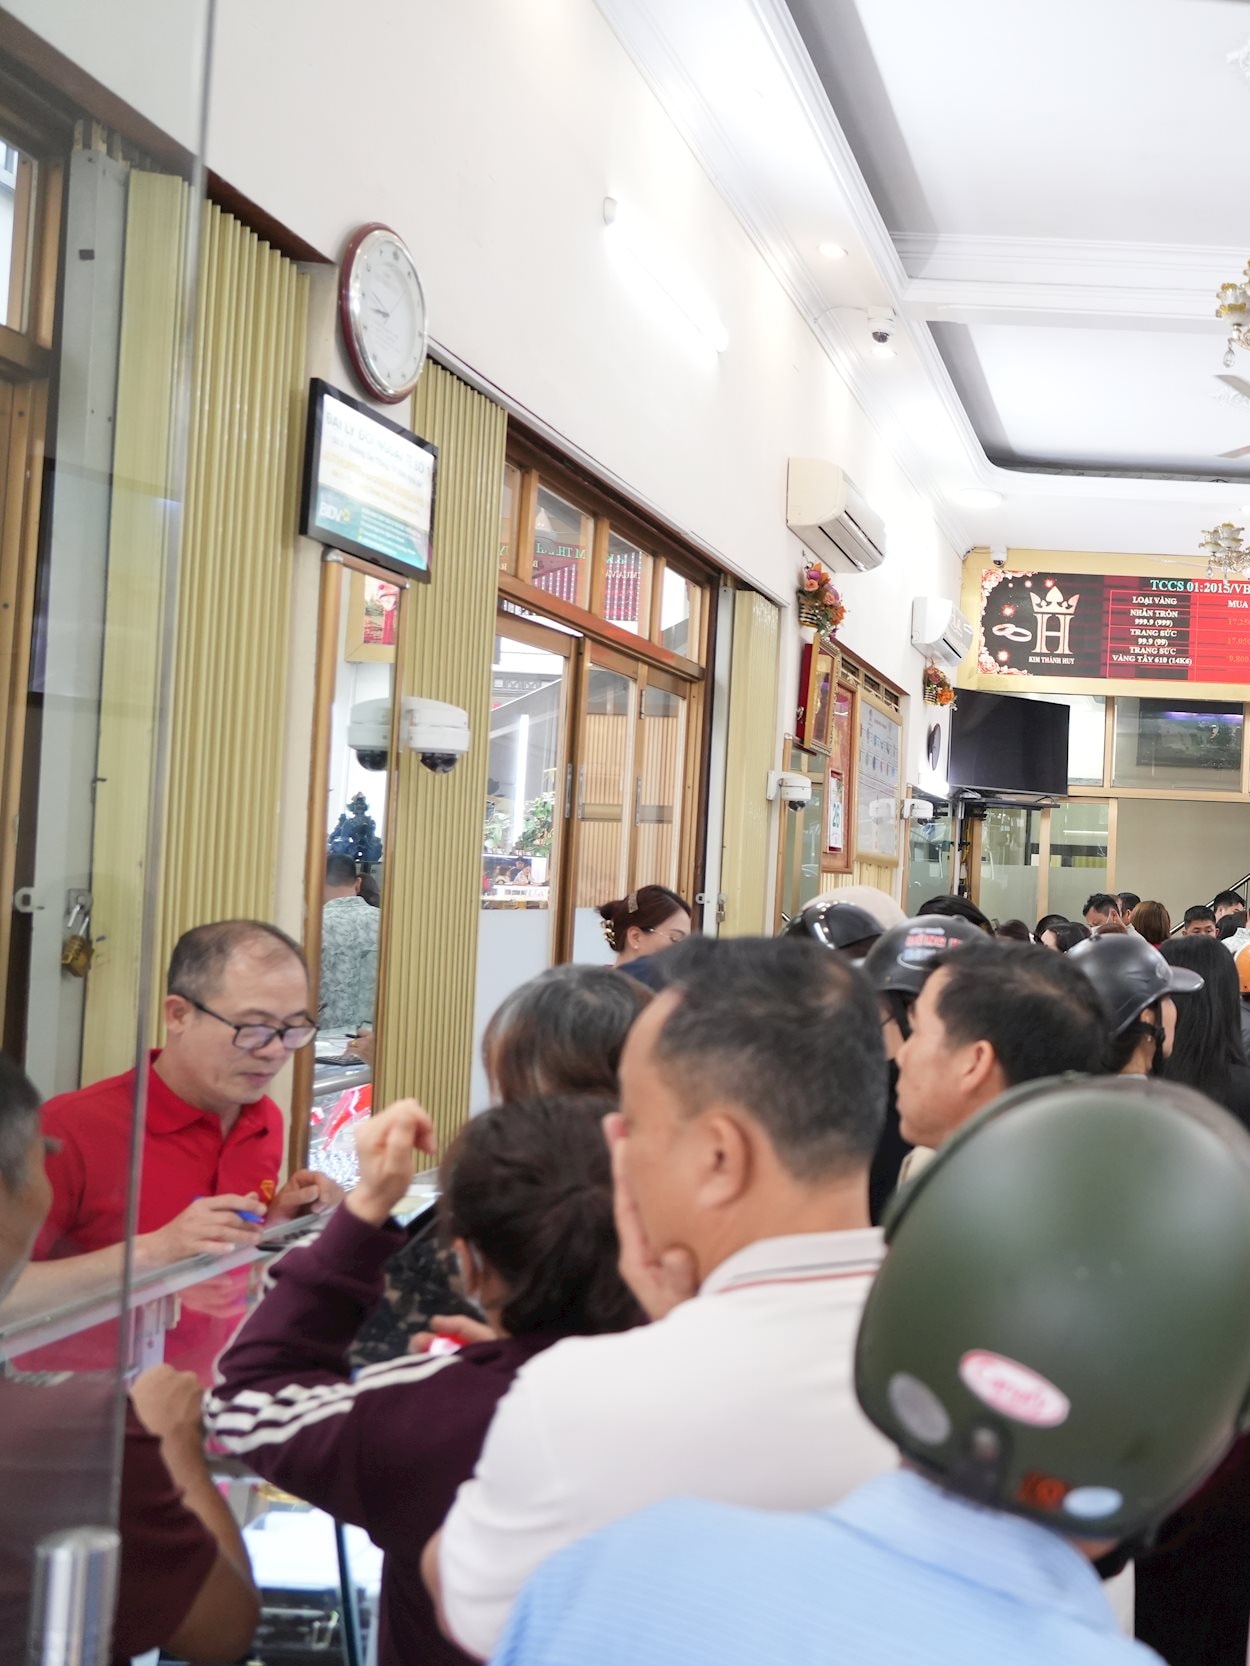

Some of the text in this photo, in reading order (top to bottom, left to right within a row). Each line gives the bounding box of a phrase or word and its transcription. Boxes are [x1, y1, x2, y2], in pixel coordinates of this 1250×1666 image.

[1150, 579, 1184, 592] TCCS
[1132, 595, 1178, 605] LOẠI VÀNG
[1228, 600, 1248, 609] MUA
[1129, 646, 1158, 654] TRANG
[1062, 657, 1075, 665] HUY
[1112, 654, 1136, 662] VÀNG
